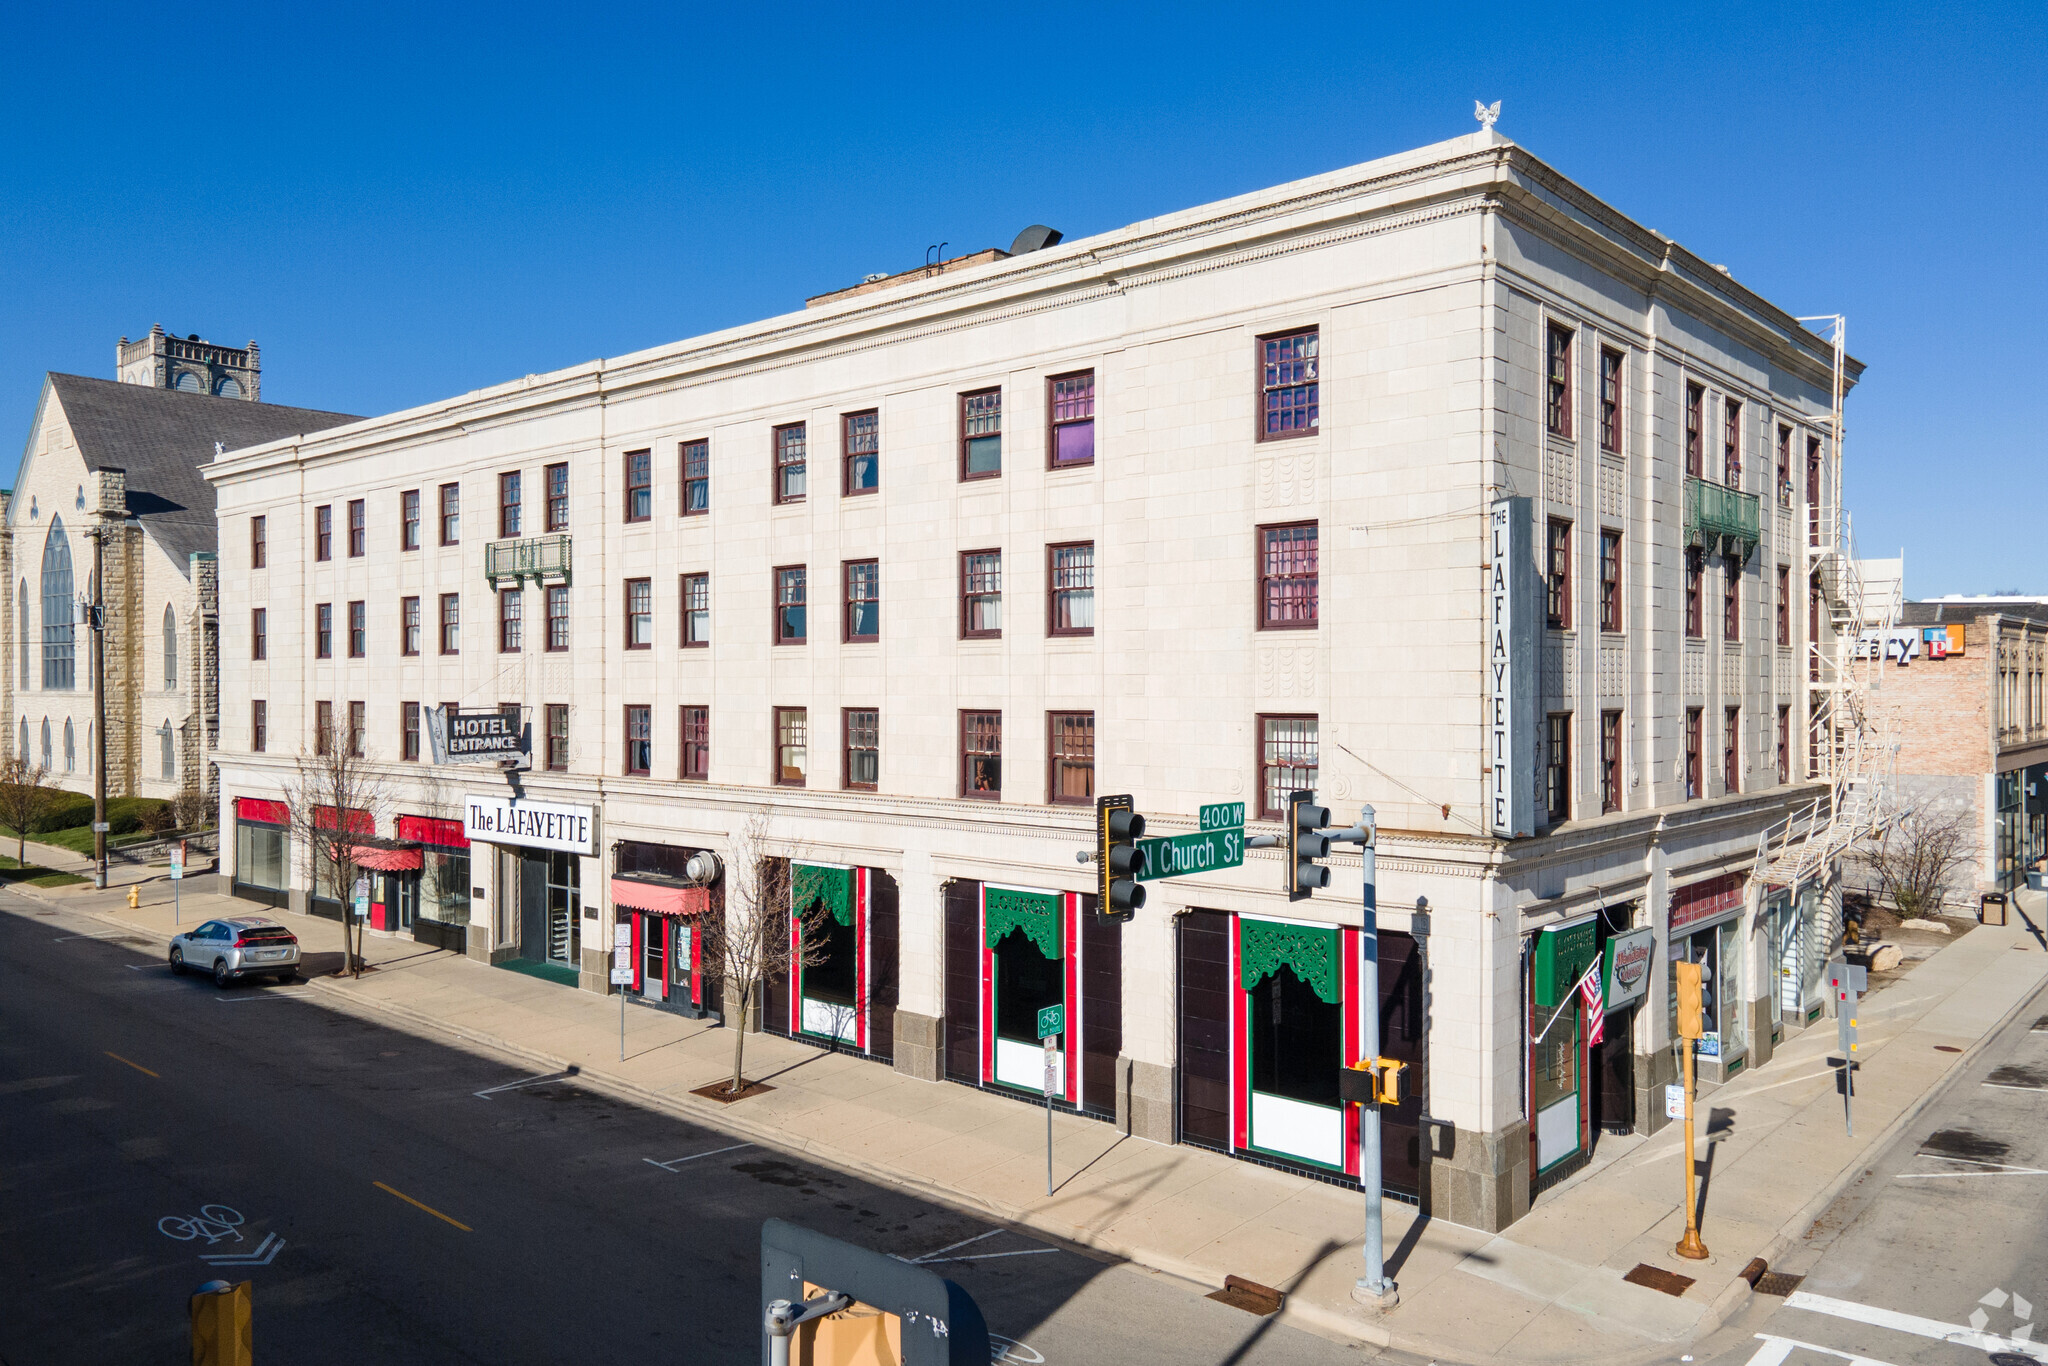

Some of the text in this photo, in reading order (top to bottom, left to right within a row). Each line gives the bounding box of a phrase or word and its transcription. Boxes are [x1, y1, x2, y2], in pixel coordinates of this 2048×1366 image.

[1490, 510, 1506, 526] THE
[1493, 530, 1506, 827] LAFAYETTE
[453, 718, 511, 736] HOTEL
[450, 736, 516, 752] ENTRANCE
[470, 805, 588, 843] The LAFAYETTE
[1202, 804, 1243, 828] 400 W
[1141, 833, 1240, 877] N Church St
[990, 894, 1049, 916] LOUNGE
